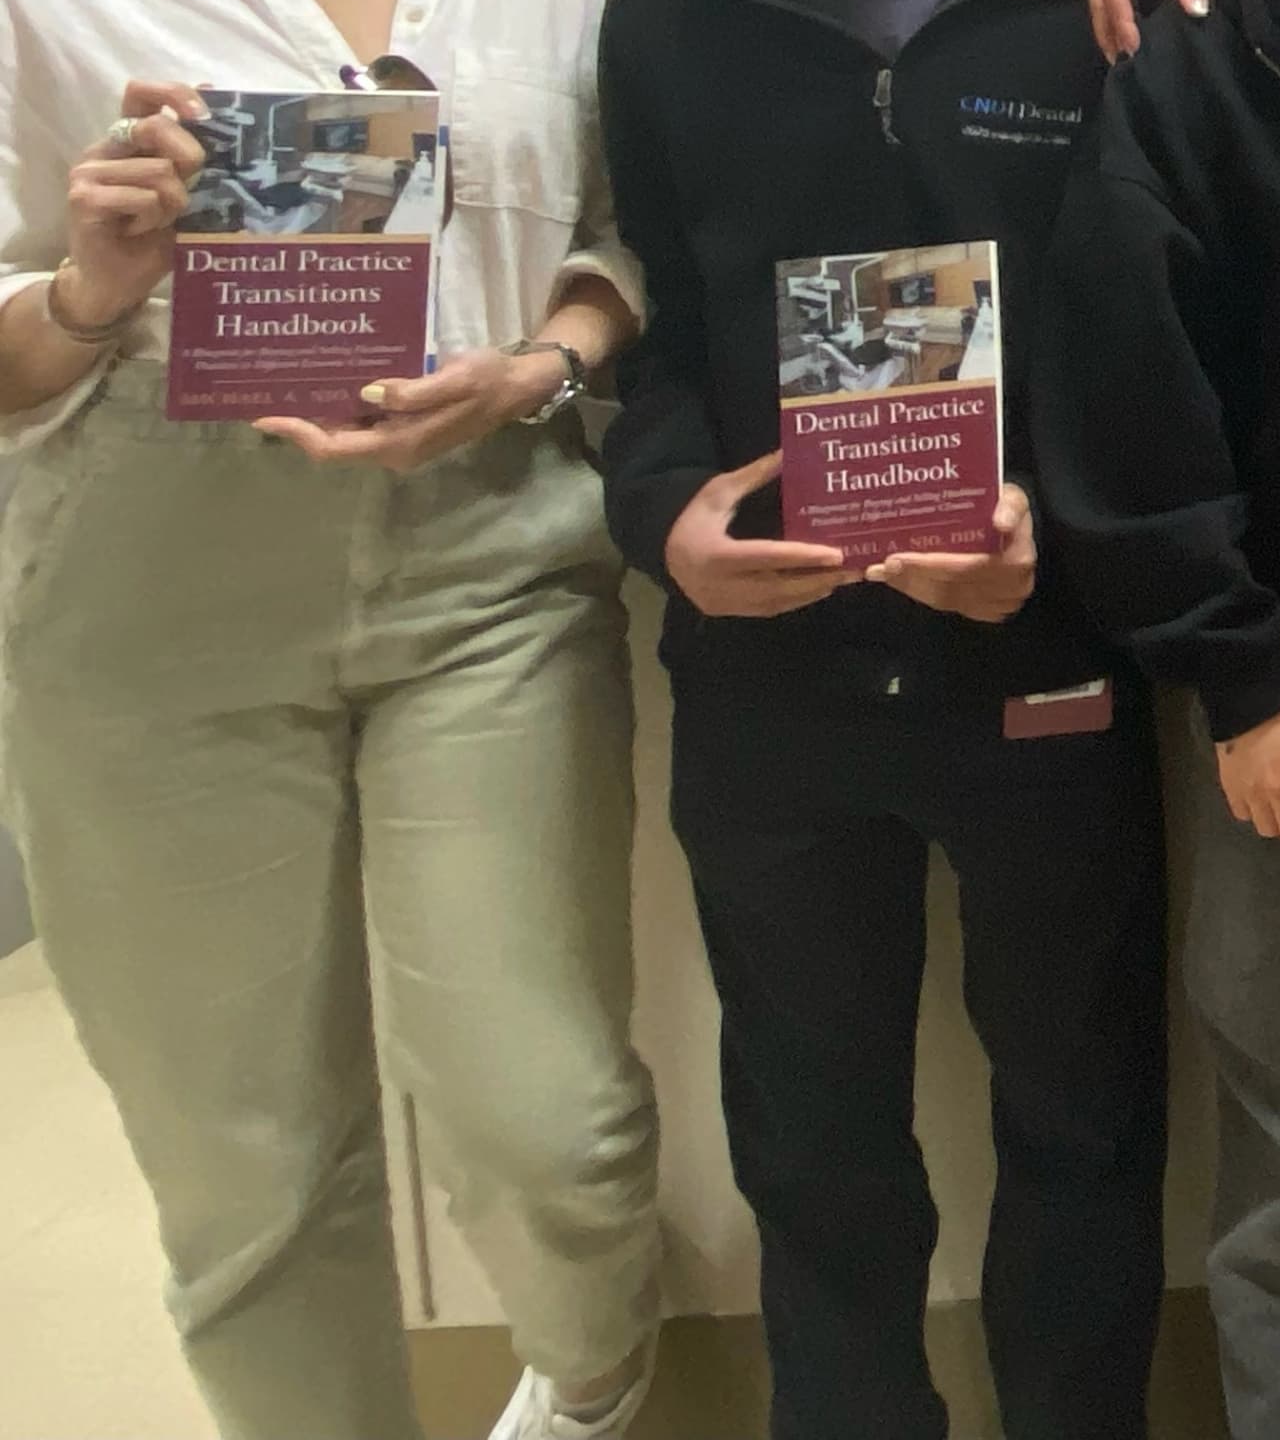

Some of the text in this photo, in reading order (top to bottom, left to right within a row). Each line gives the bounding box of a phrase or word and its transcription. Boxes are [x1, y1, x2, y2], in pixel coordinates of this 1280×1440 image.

[186, 249, 412, 271] Dental Practice
[212, 281, 382, 304] Transitions
[215, 313, 377, 336] Handbook
[795, 397, 985, 433] Dental Practice
[820, 429, 962, 461] Transitions
[825, 457, 960, 491] Handbook
